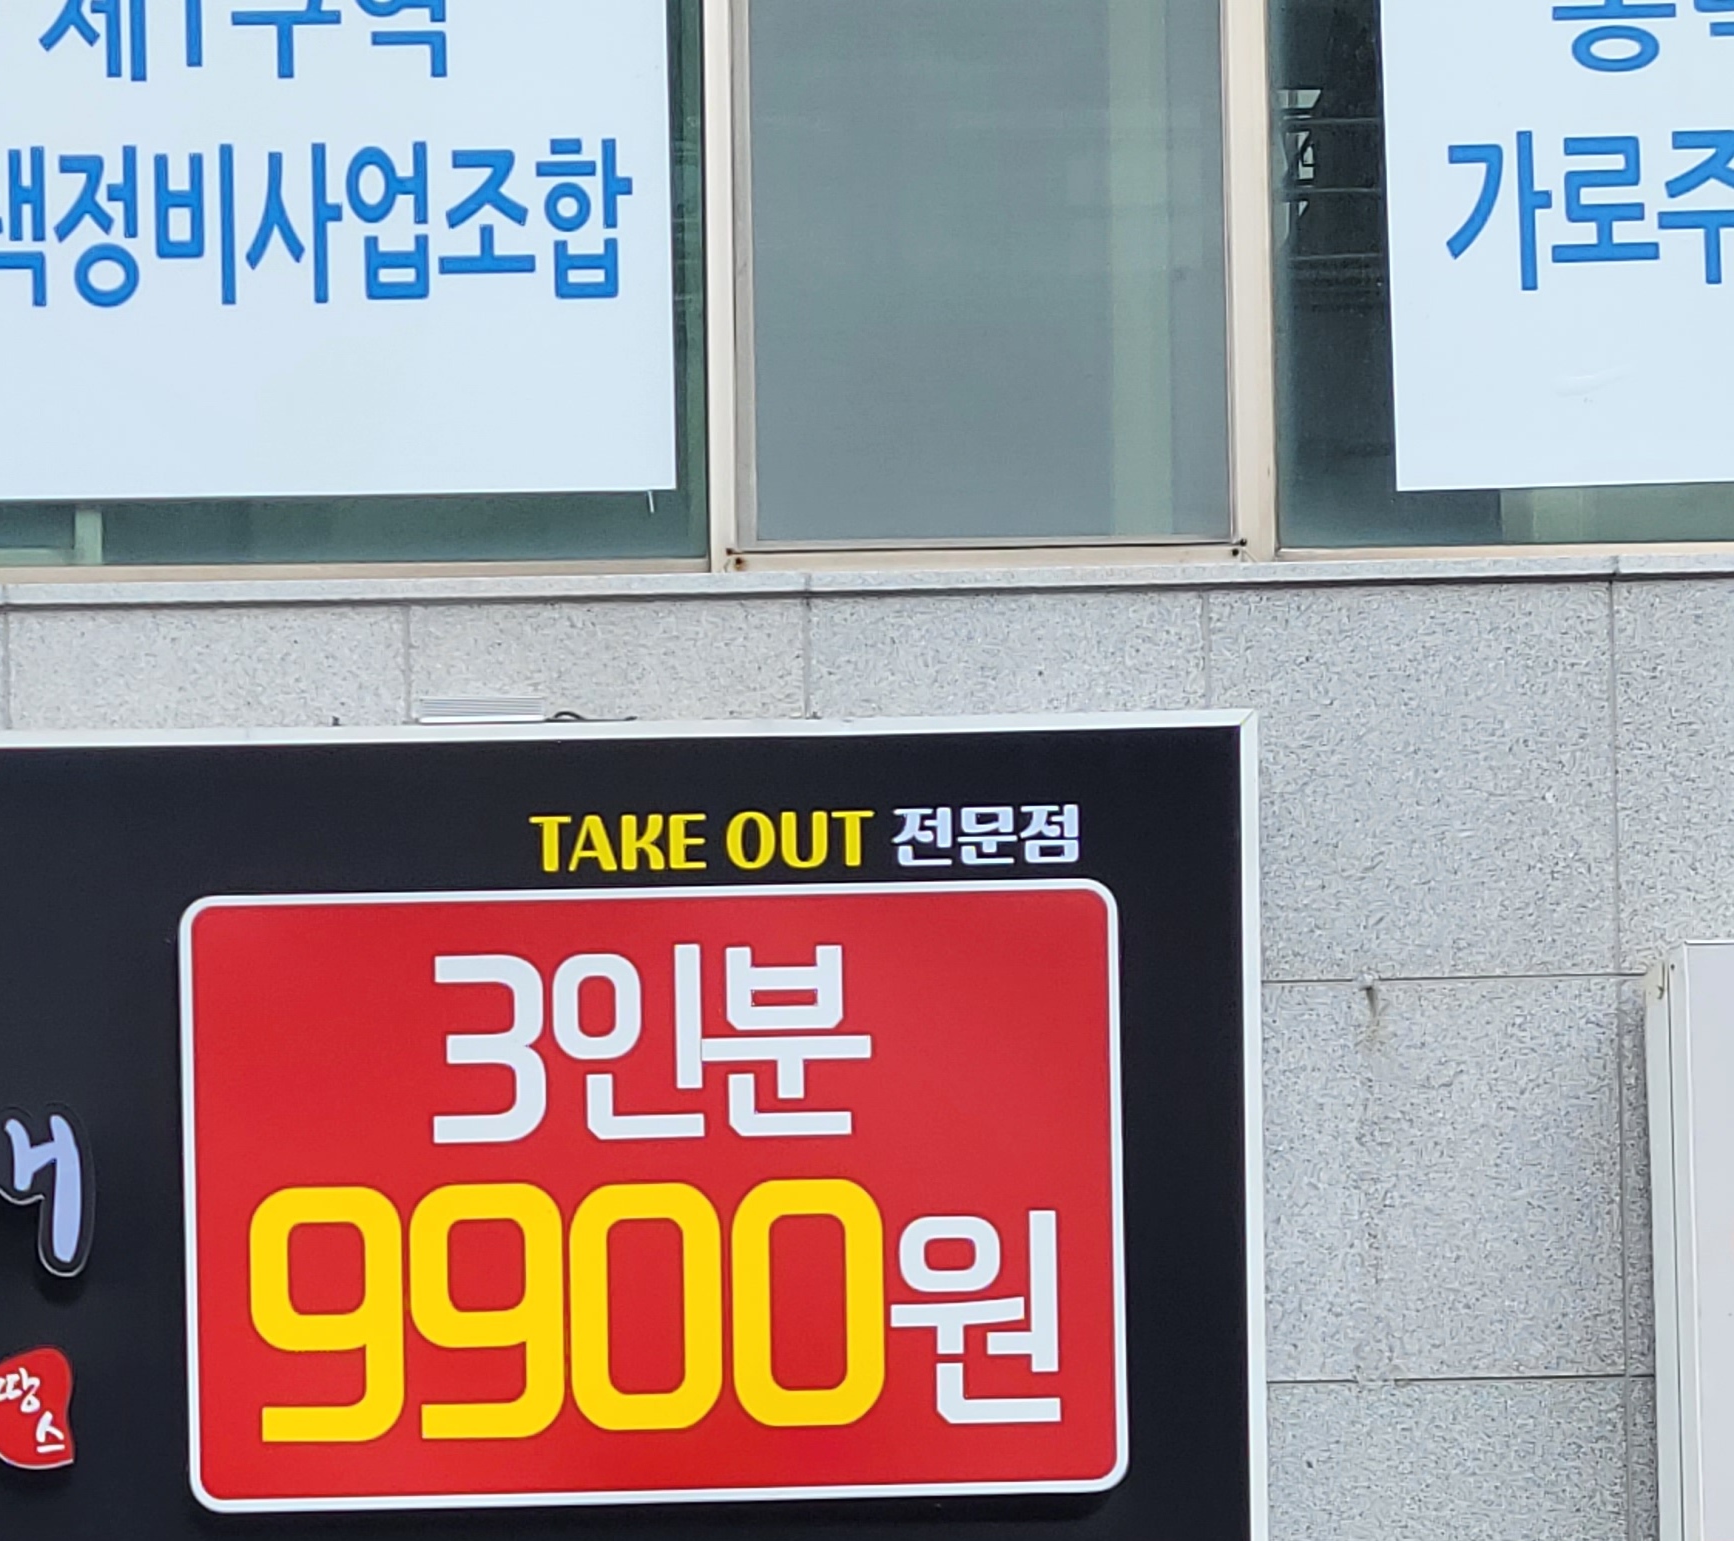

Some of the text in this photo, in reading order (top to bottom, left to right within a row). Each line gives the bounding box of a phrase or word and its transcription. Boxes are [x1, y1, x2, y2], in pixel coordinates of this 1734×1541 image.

[530, 804, 1081, 872] TAKE OUT 전문점
[432, 941, 873, 1144] 3인분
[247, 1177, 1063, 1444] 9900원
